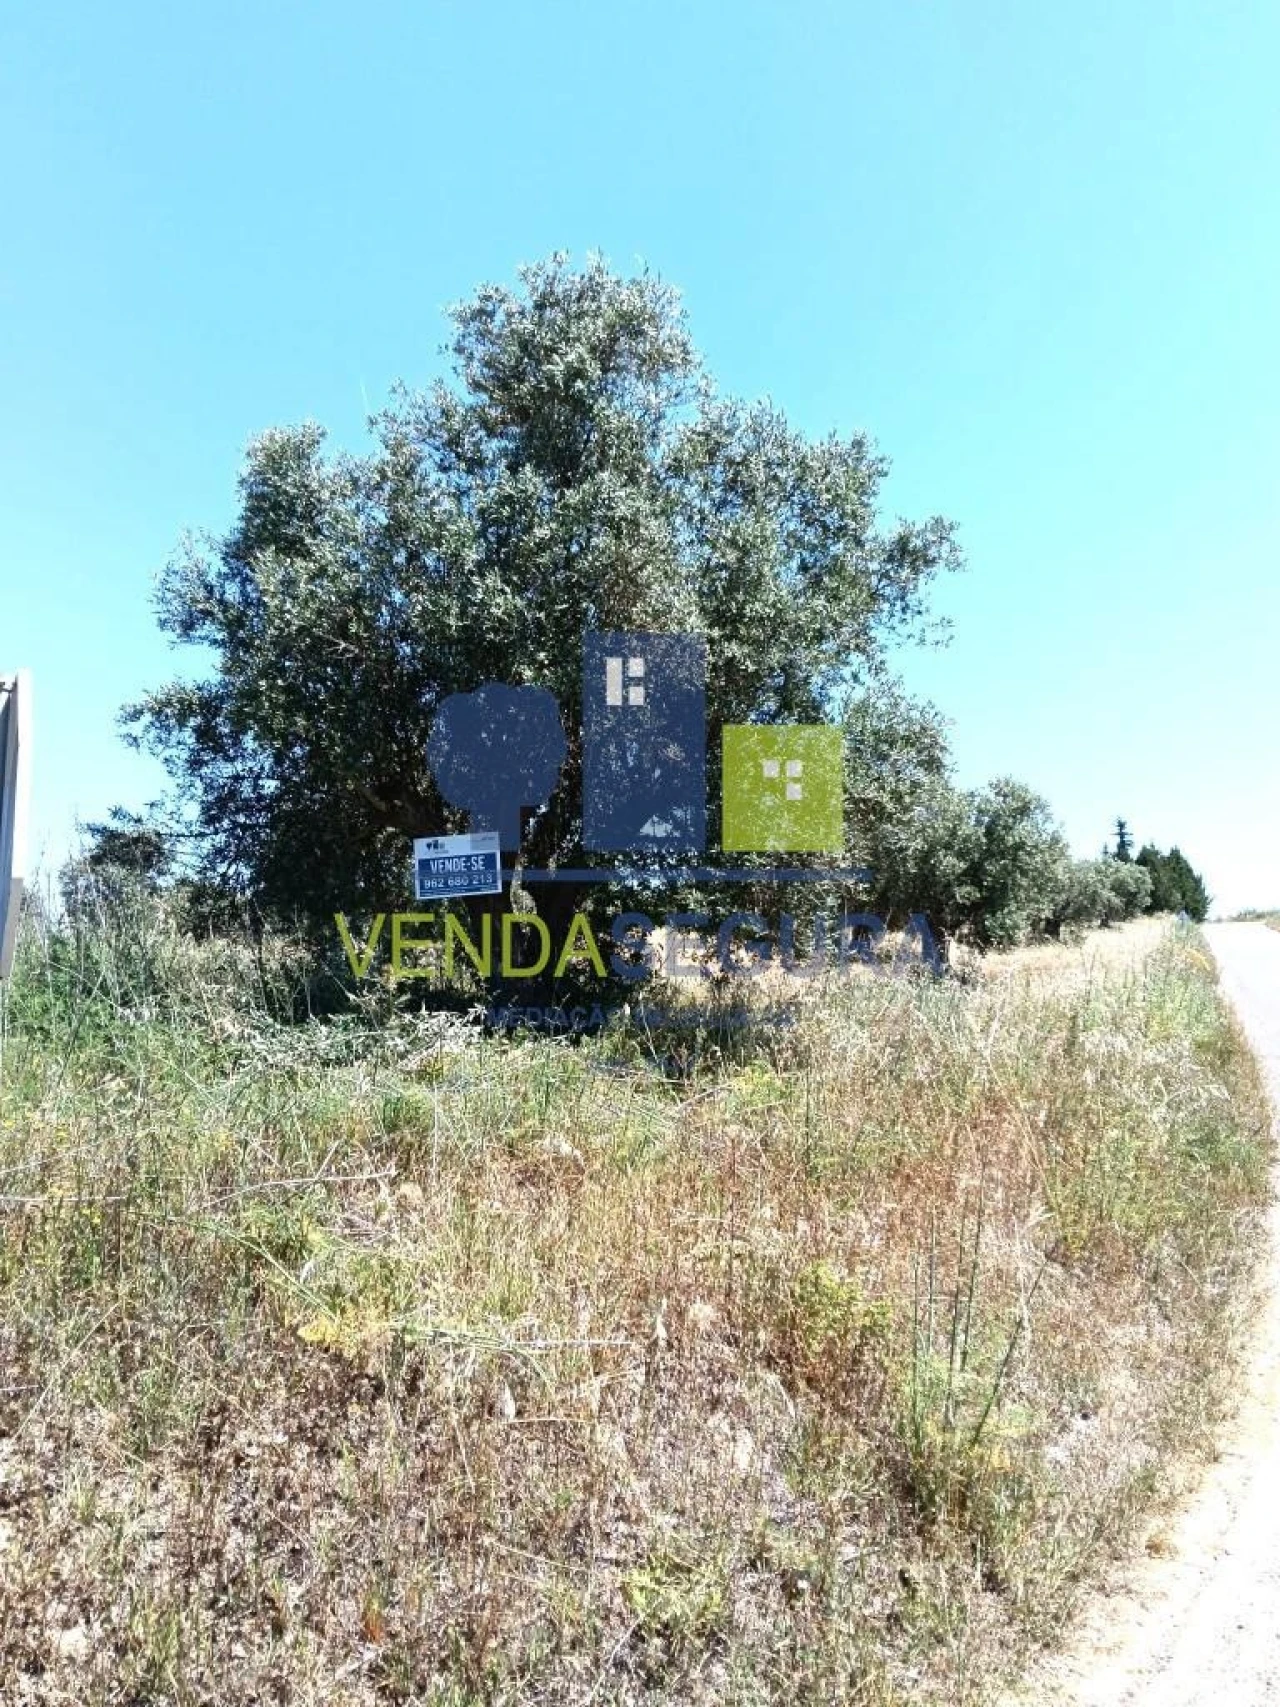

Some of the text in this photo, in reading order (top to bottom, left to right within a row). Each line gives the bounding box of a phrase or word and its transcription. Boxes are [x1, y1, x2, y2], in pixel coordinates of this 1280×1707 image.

[429, 856, 486, 874] VENDE-SE
[424, 878, 444, 889] 962
[448, 876, 469, 886] 680
